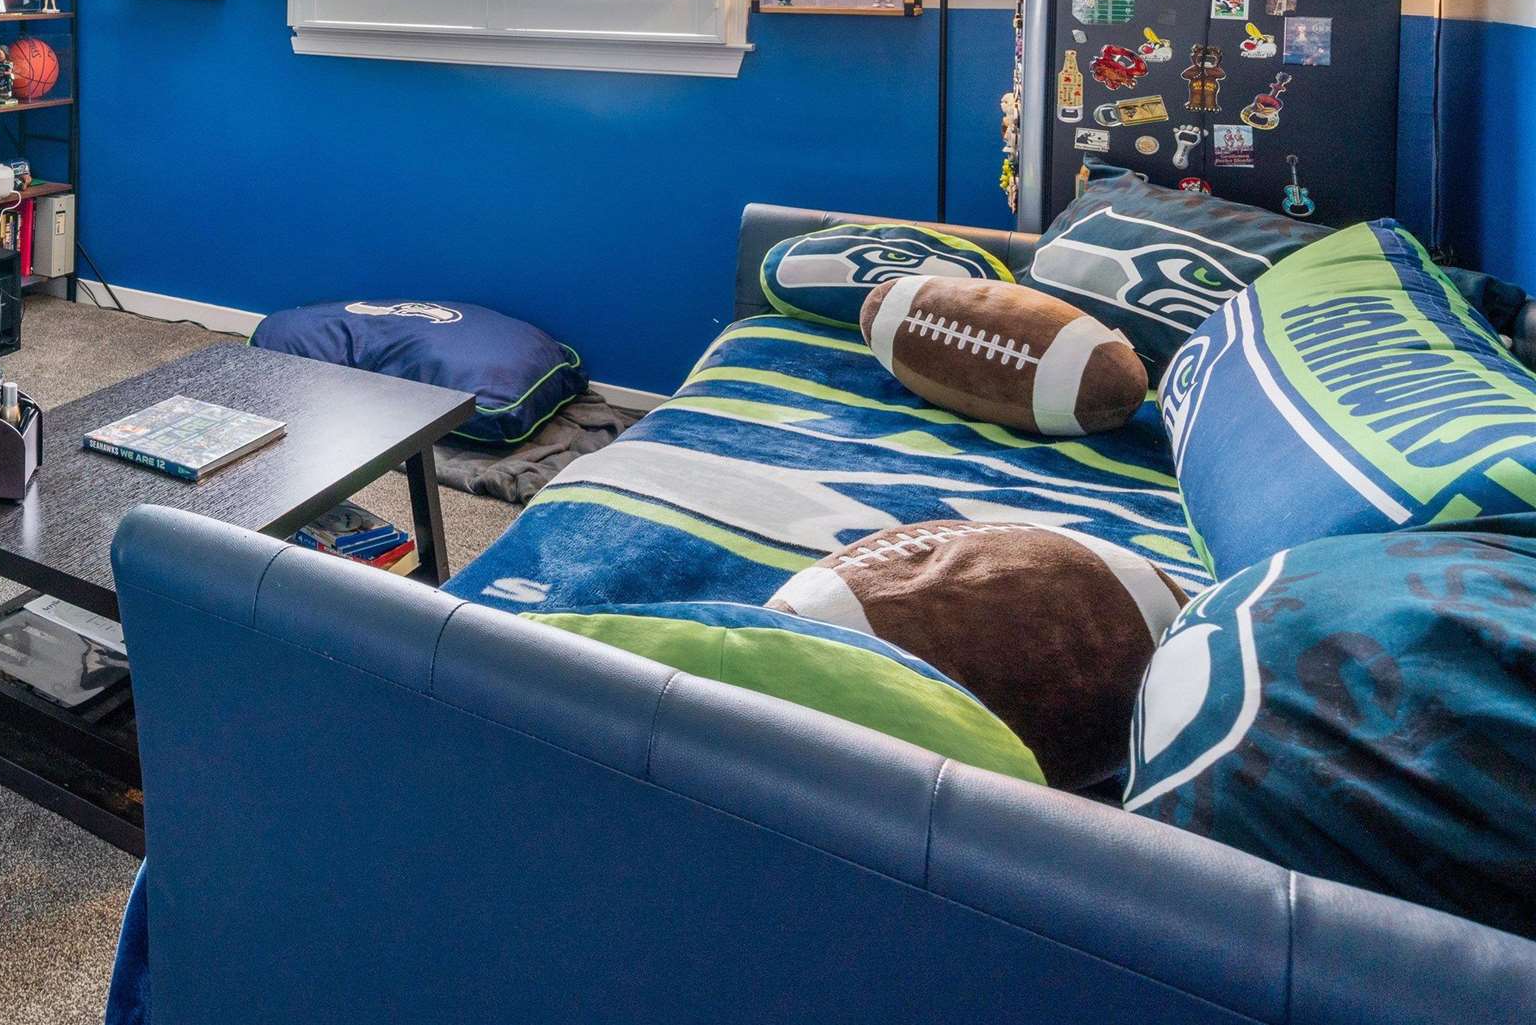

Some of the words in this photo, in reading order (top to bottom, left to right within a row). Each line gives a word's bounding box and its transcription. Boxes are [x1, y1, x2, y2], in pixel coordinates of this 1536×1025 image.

[1279, 294, 1536, 469] SEAHAWKS
[89, 439, 119, 456] SEAHAWKS
[119, 448, 134, 461] WE
[135, 451, 155, 467] ARE
[156, 457, 166, 469] 12
